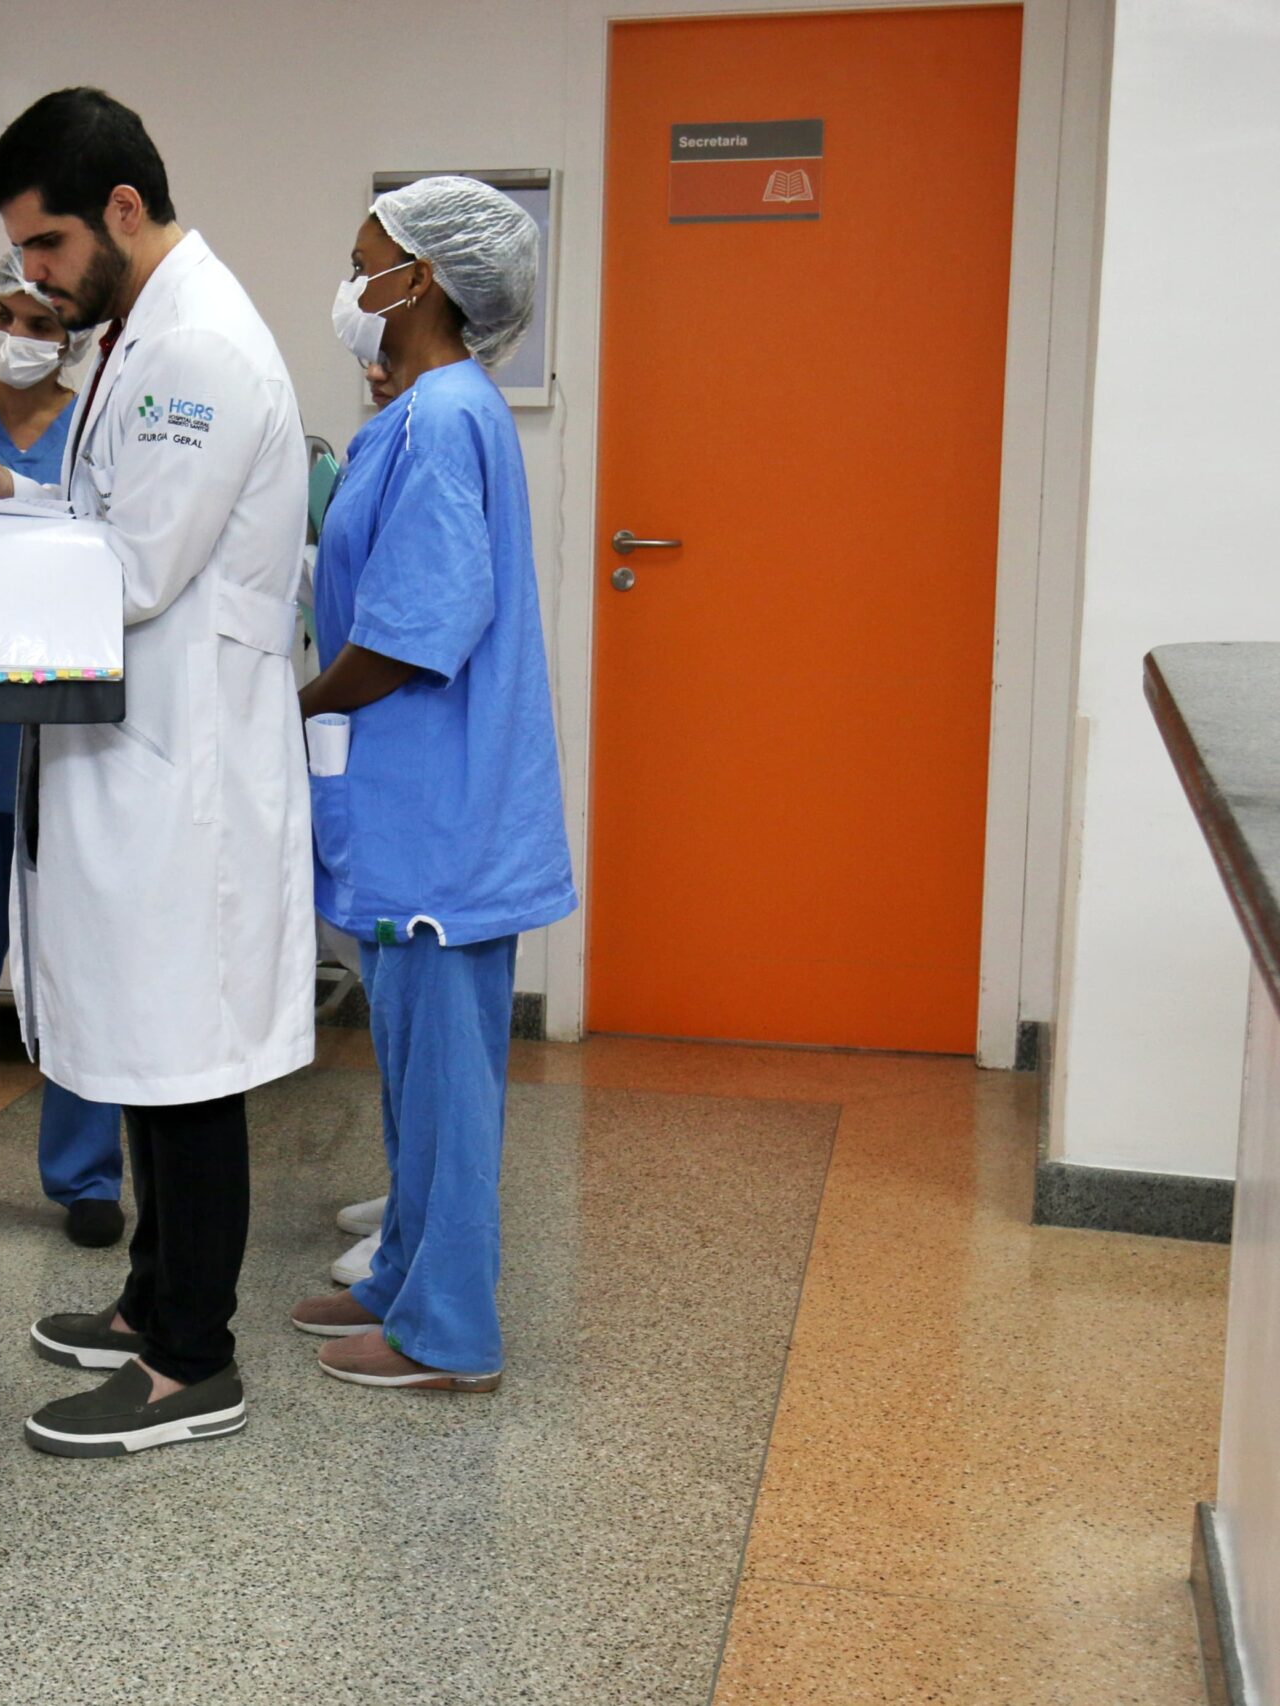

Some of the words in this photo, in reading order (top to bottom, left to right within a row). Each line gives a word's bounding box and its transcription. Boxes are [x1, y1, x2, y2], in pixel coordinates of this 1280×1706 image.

[679, 134, 748, 148] Secretaria
[169, 398, 214, 421] HGRS
[173, 434, 202, 449] GERAL
